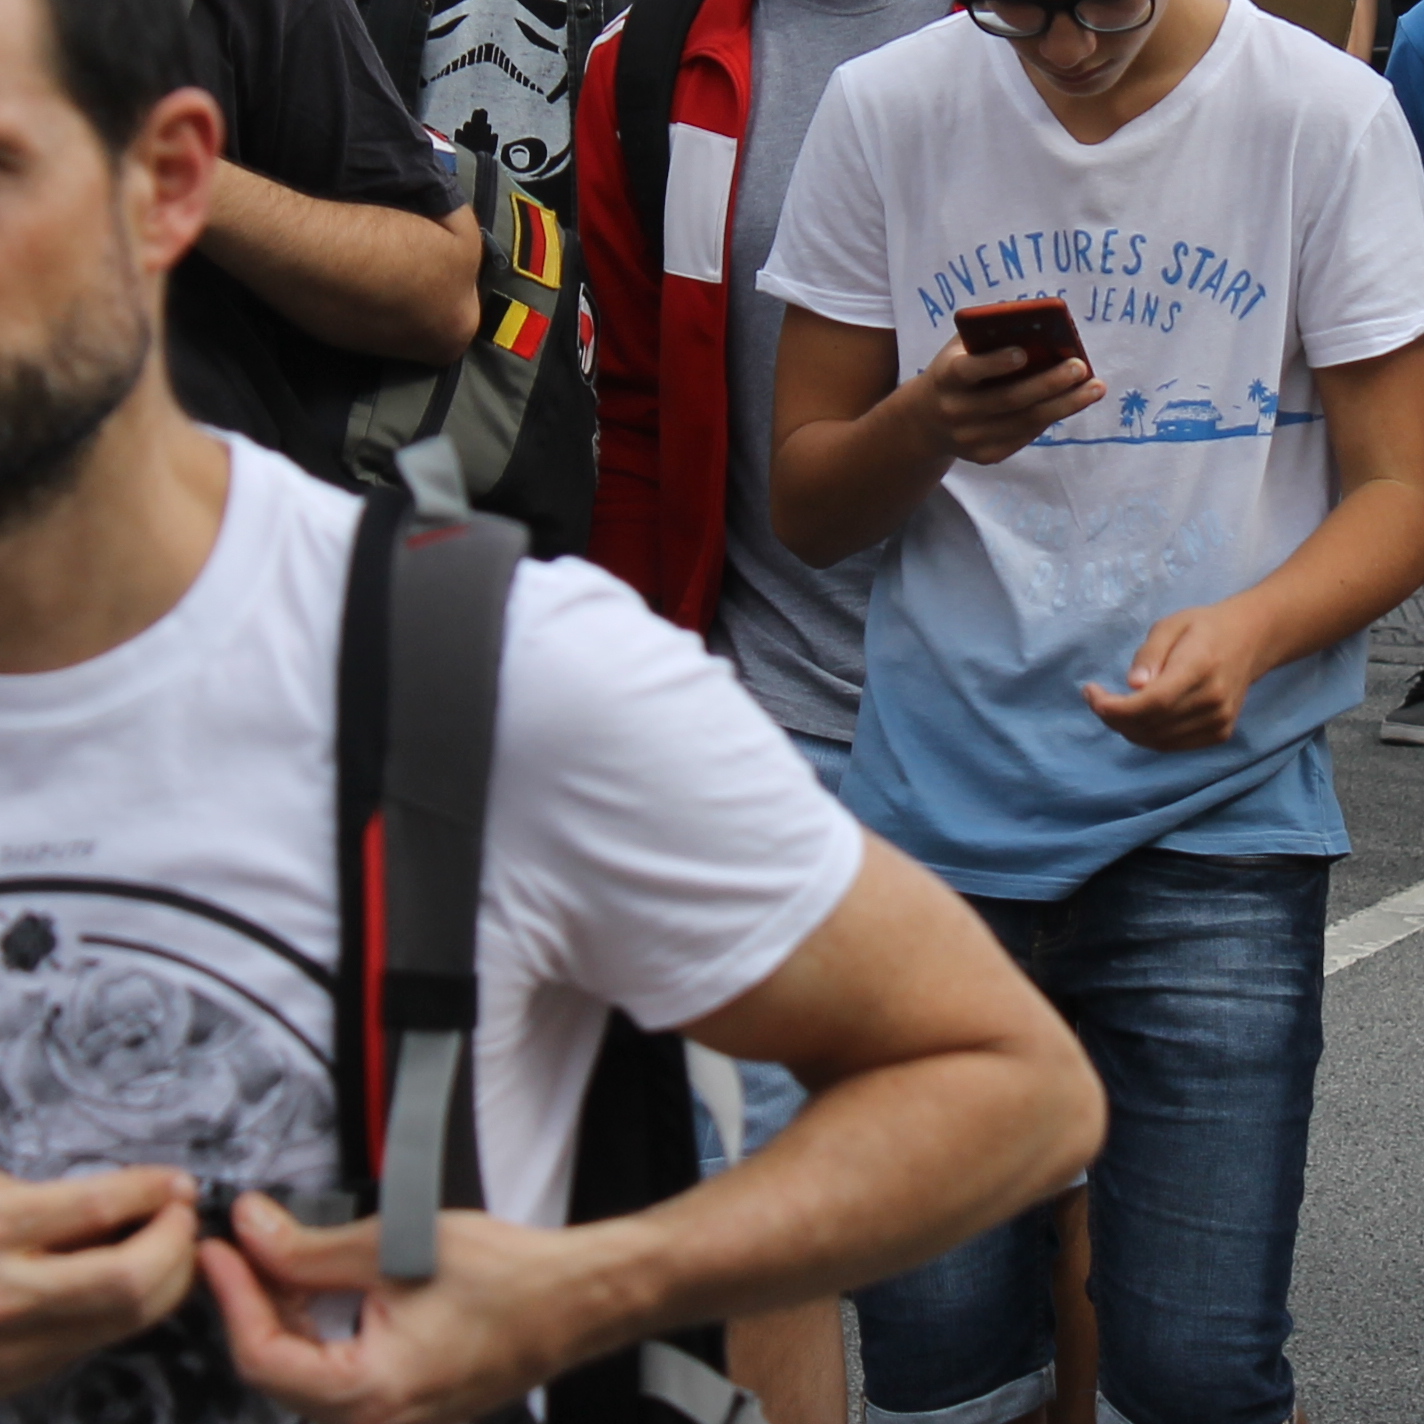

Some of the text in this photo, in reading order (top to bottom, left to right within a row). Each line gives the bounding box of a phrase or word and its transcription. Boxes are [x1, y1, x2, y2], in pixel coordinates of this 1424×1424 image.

[916, 227, 1269, 329] ADVENTURES START
[1084, 285, 1184, 334] JEANS
